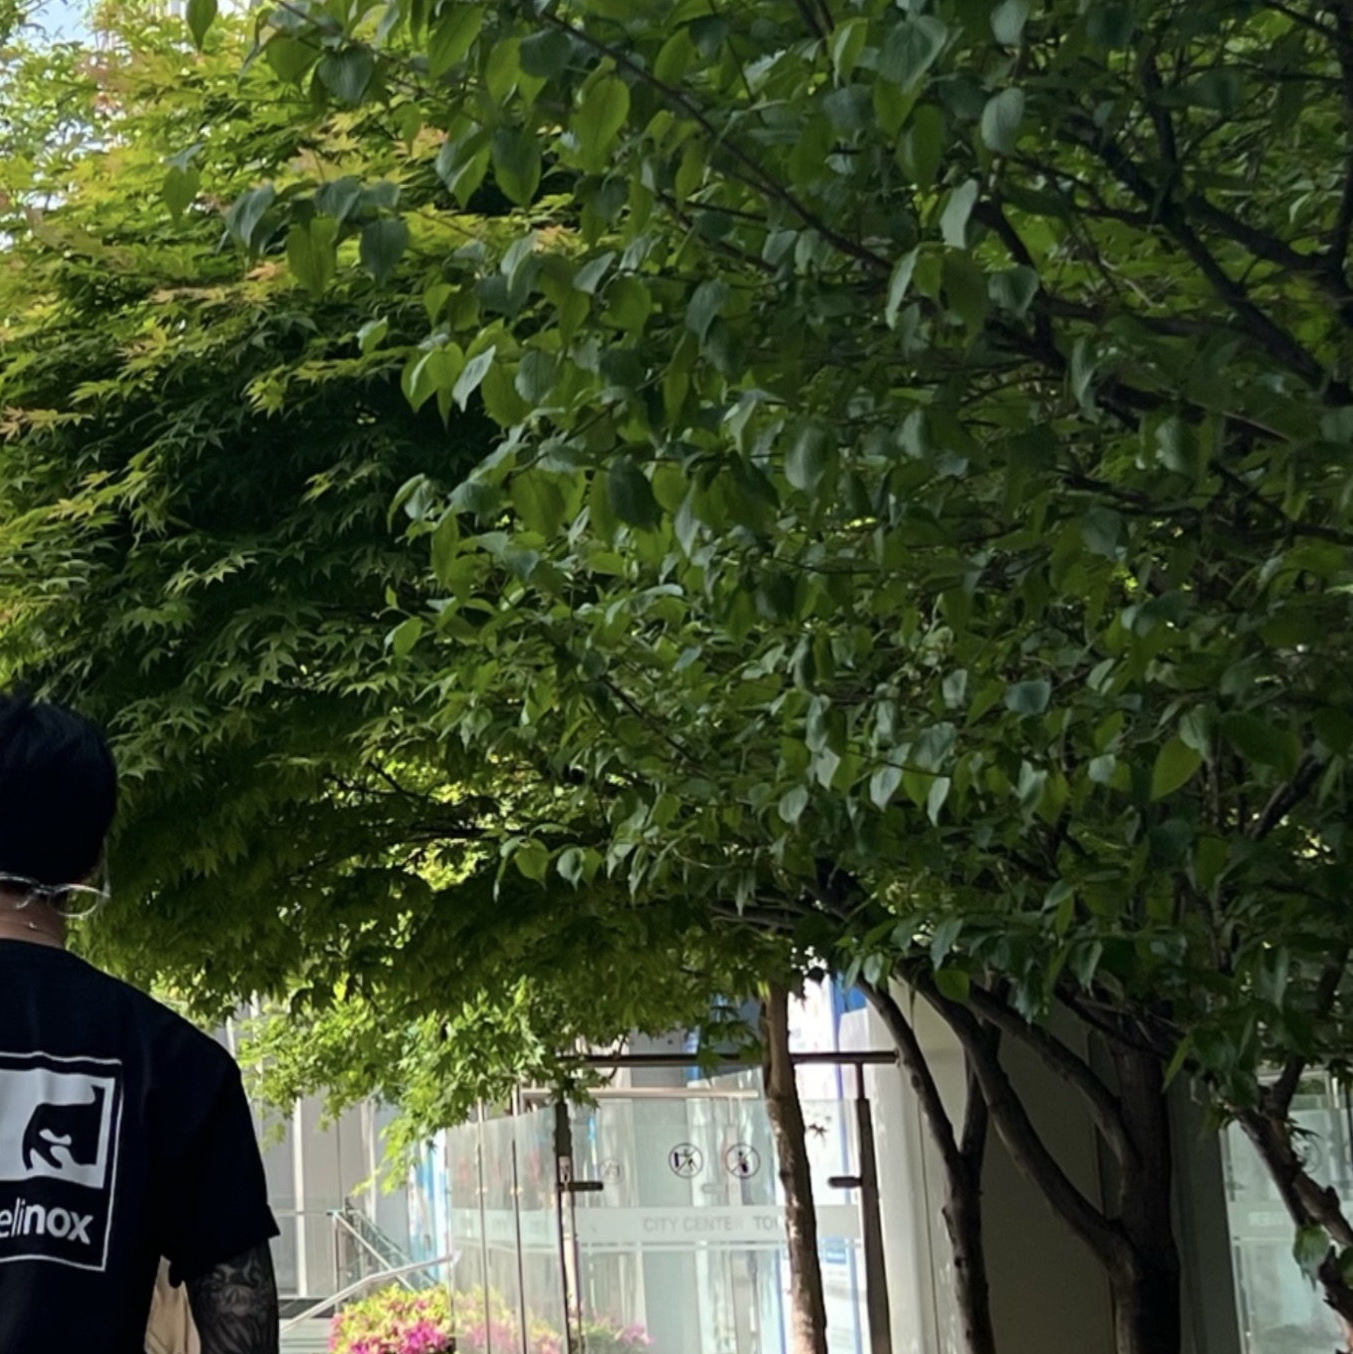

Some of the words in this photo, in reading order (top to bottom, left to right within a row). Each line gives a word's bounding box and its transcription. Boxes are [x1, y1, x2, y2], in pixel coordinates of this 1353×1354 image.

[643, 1215, 679, 1232] CITY
[682, 1215, 744, 1232] CENTER
[752, 1213, 778, 1231] TO
